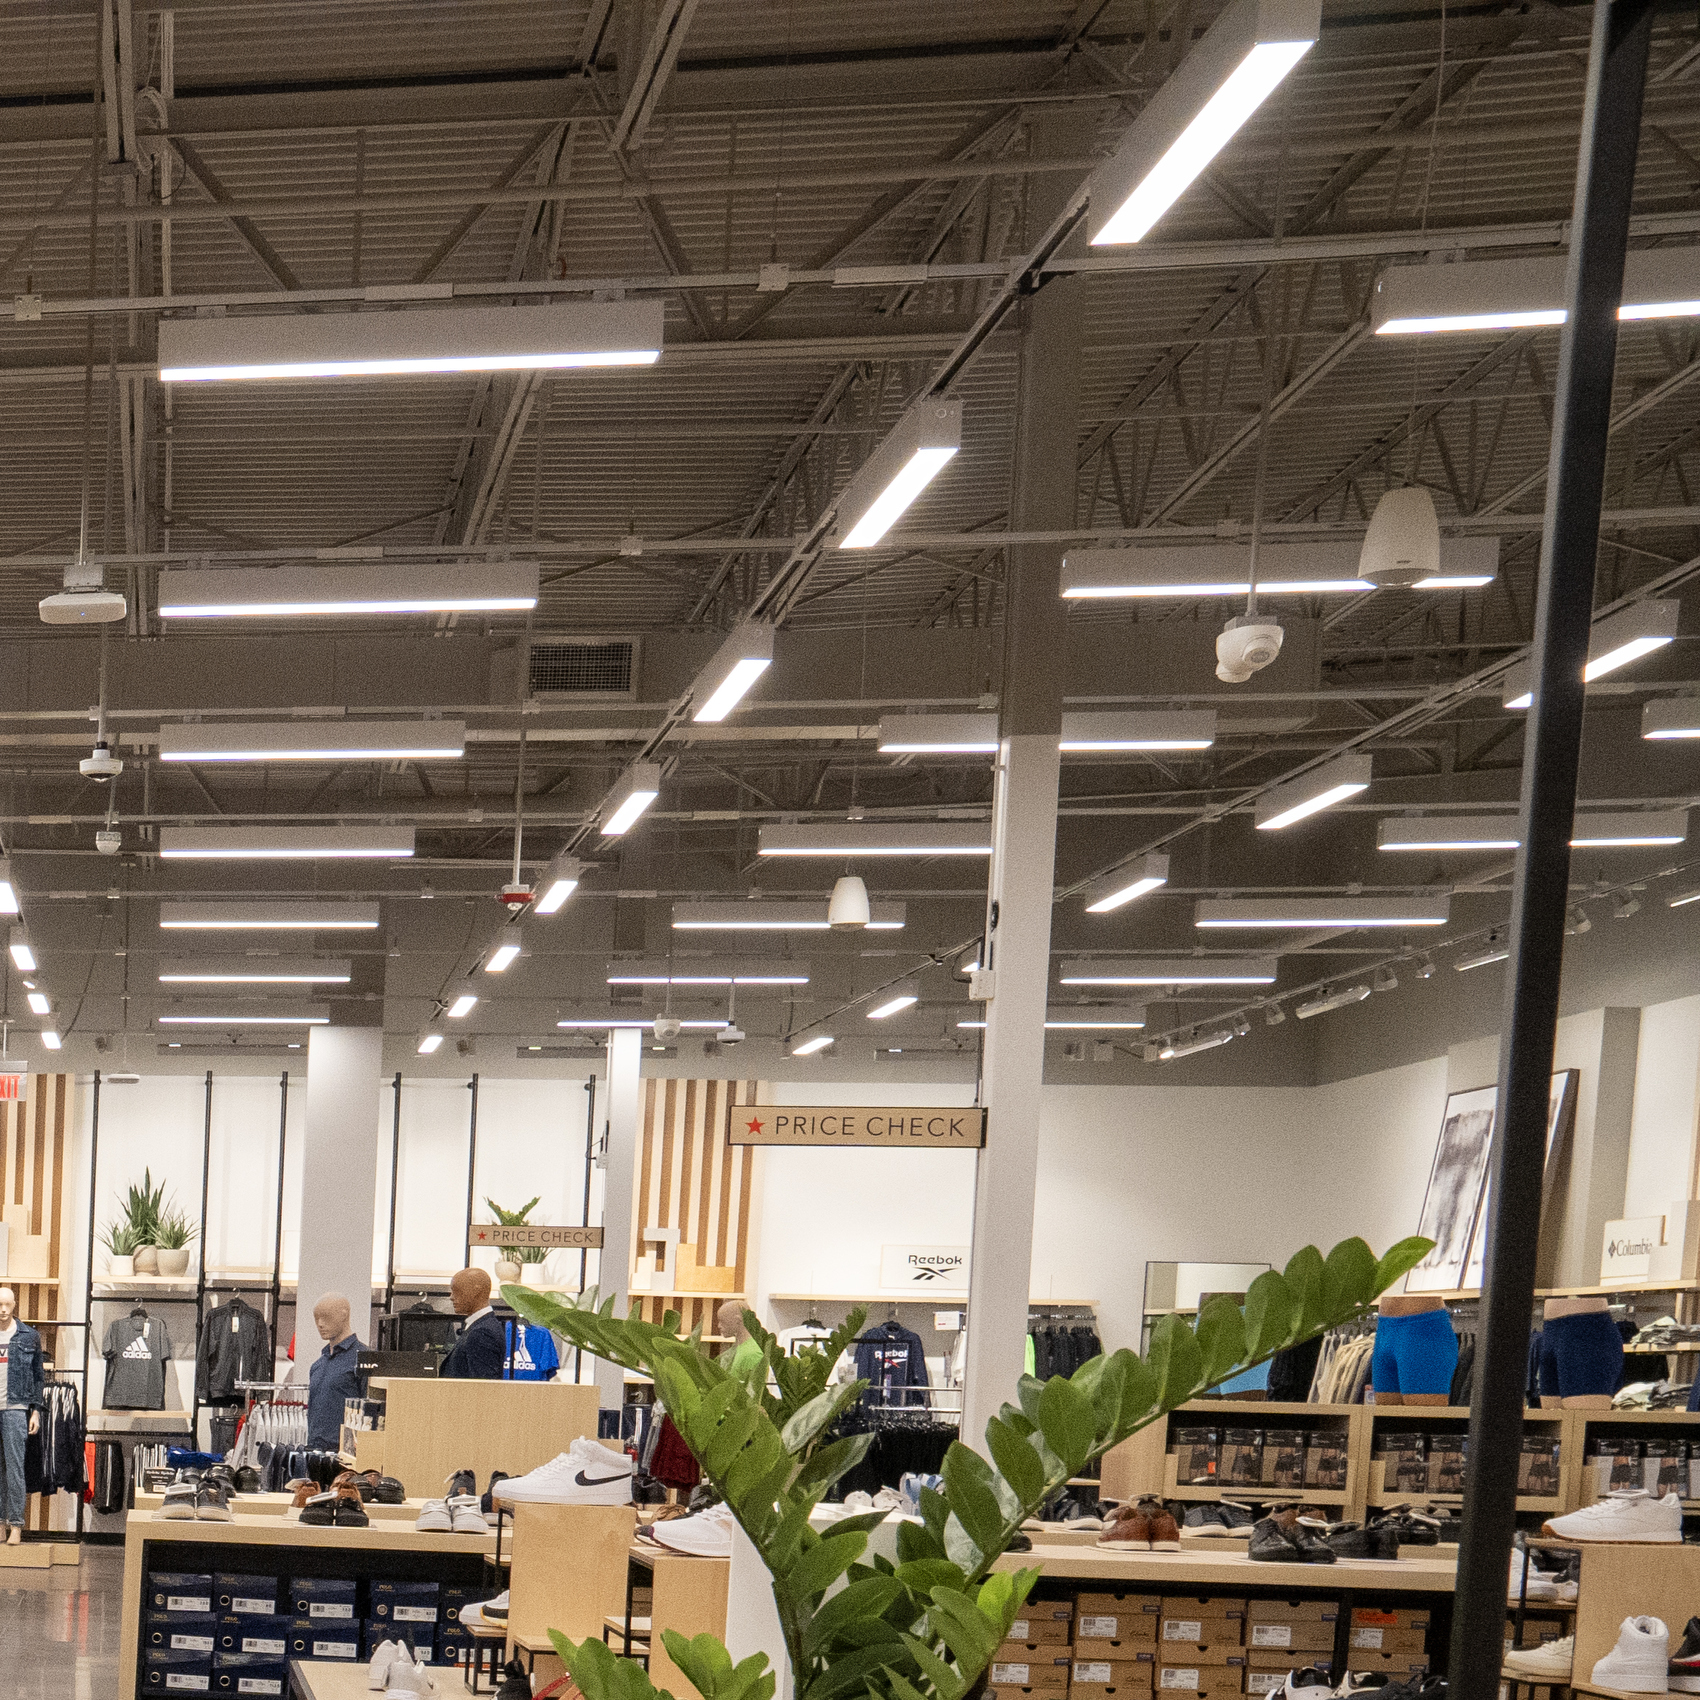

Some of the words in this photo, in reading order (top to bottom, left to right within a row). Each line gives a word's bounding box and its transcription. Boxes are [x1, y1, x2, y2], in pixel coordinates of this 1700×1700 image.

[775, 1115, 855, 1135] PRICE
[866, 1117, 965, 1137] CHECK
[492, 1230, 536, 1242] PRICE
[540, 1230, 594, 1243] CHECK
[908, 1254, 962, 1266] Reebok
[122, 1350, 152, 1360] adidas
